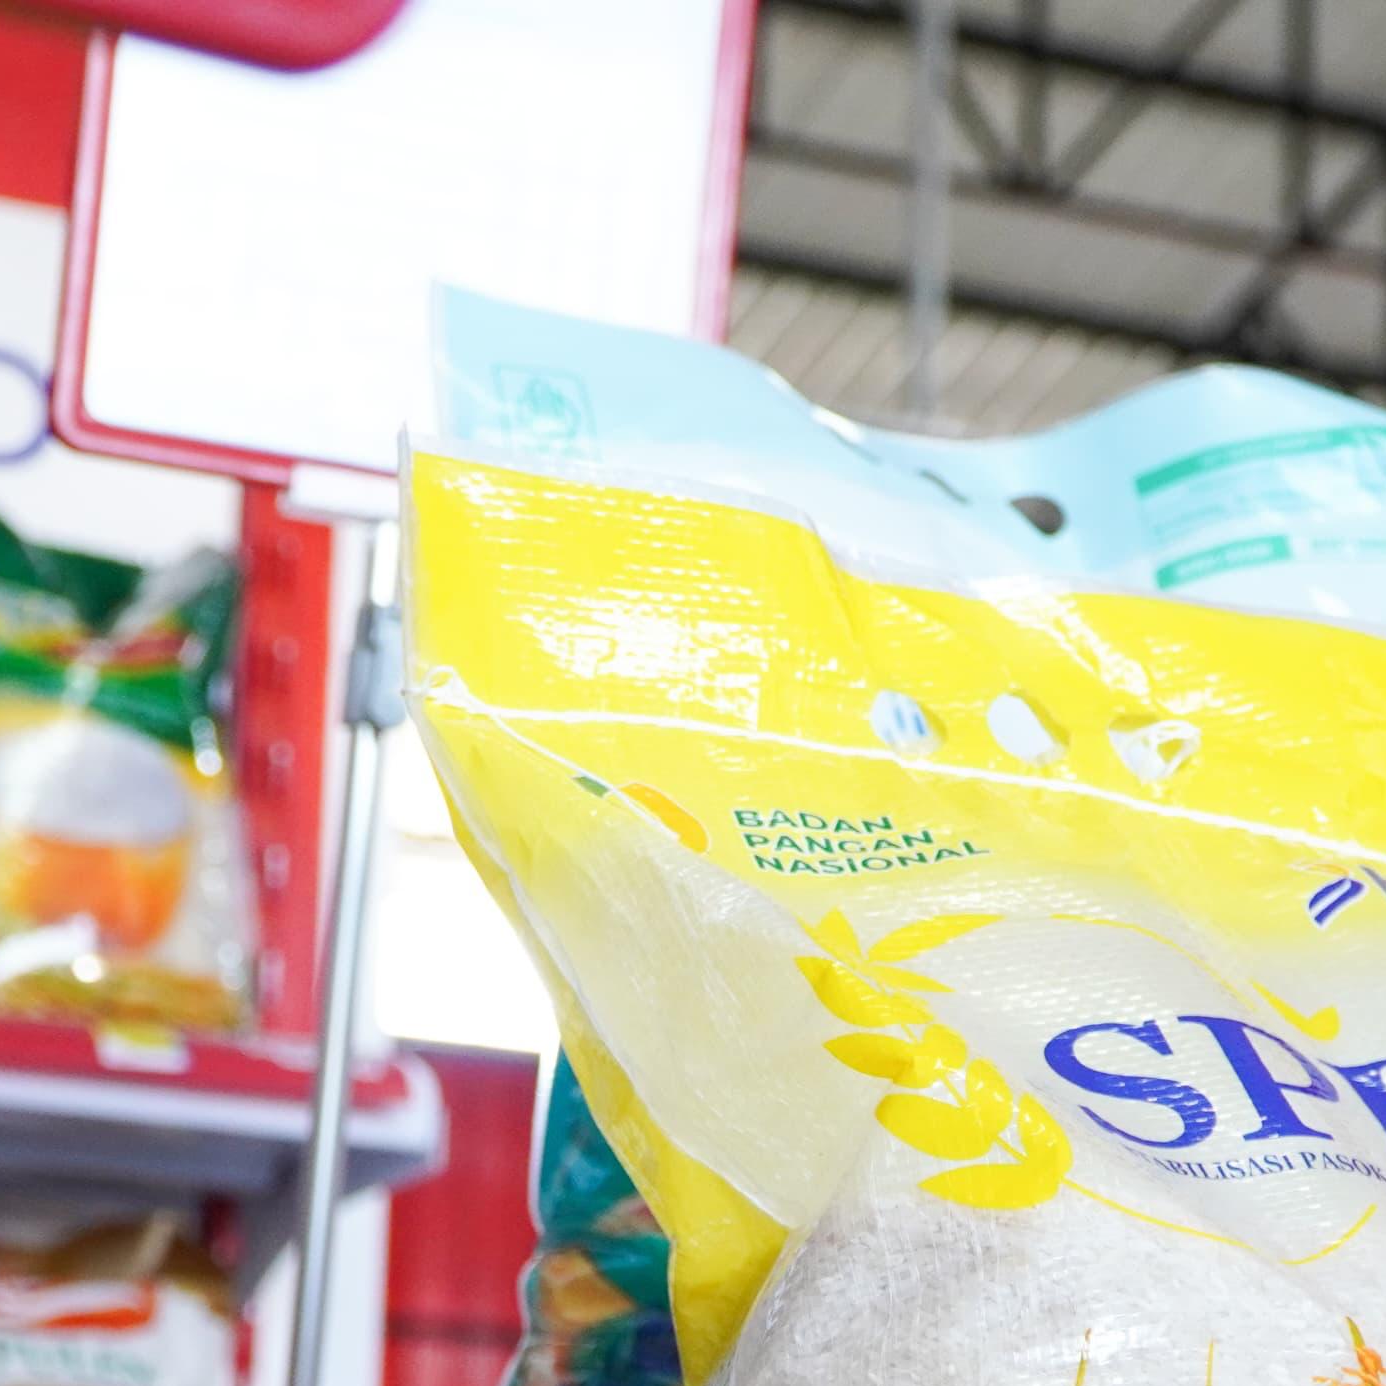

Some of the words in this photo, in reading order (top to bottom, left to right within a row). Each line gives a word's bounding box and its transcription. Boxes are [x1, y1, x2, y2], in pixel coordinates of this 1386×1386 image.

[733, 810, 894, 834] BADAN
[743, 830, 934, 854] PANGAN
[754, 841, 990, 874] NASIONAL
